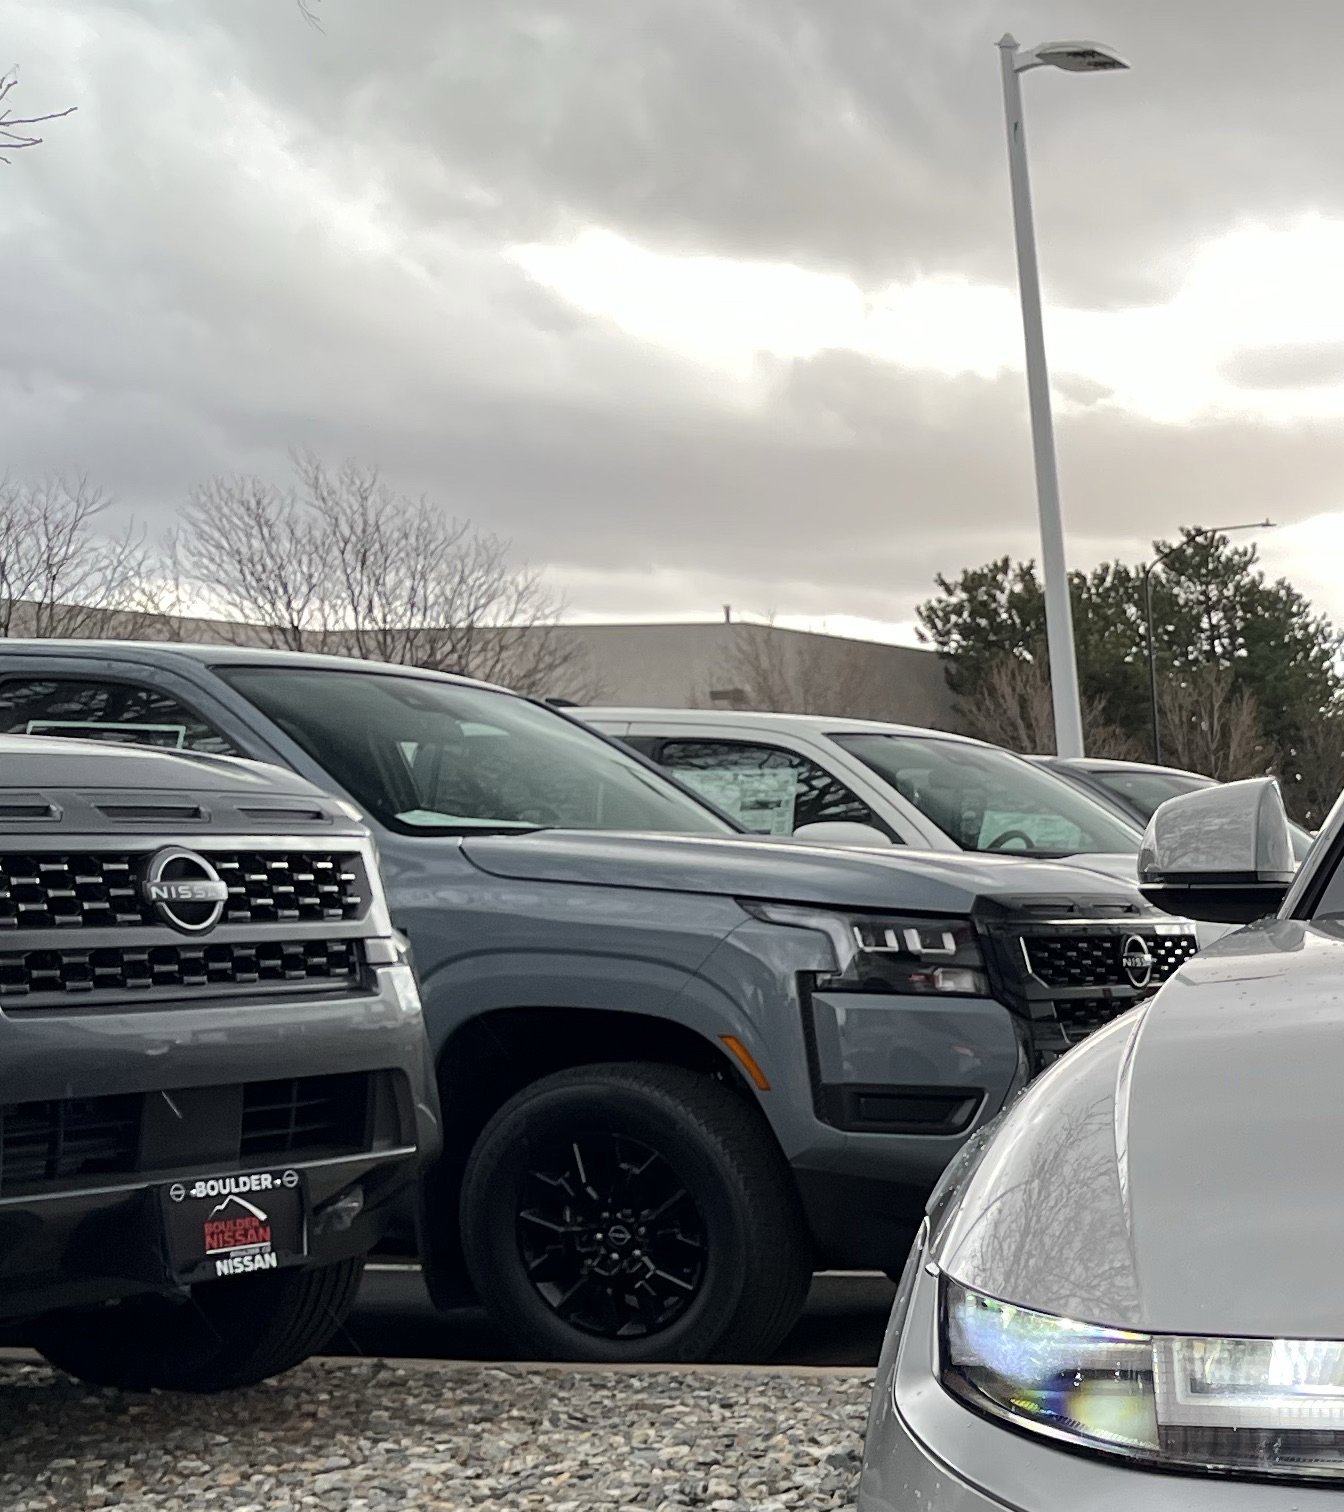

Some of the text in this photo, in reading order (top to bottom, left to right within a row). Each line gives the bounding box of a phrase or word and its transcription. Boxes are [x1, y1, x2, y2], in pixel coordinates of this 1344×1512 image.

[151, 886, 219, 899] NISS
[195, 1174, 272, 1197] BOULDER
[206, 1226, 271, 1250] NISSAN
[216, 1252, 277, 1276] NISSAN
